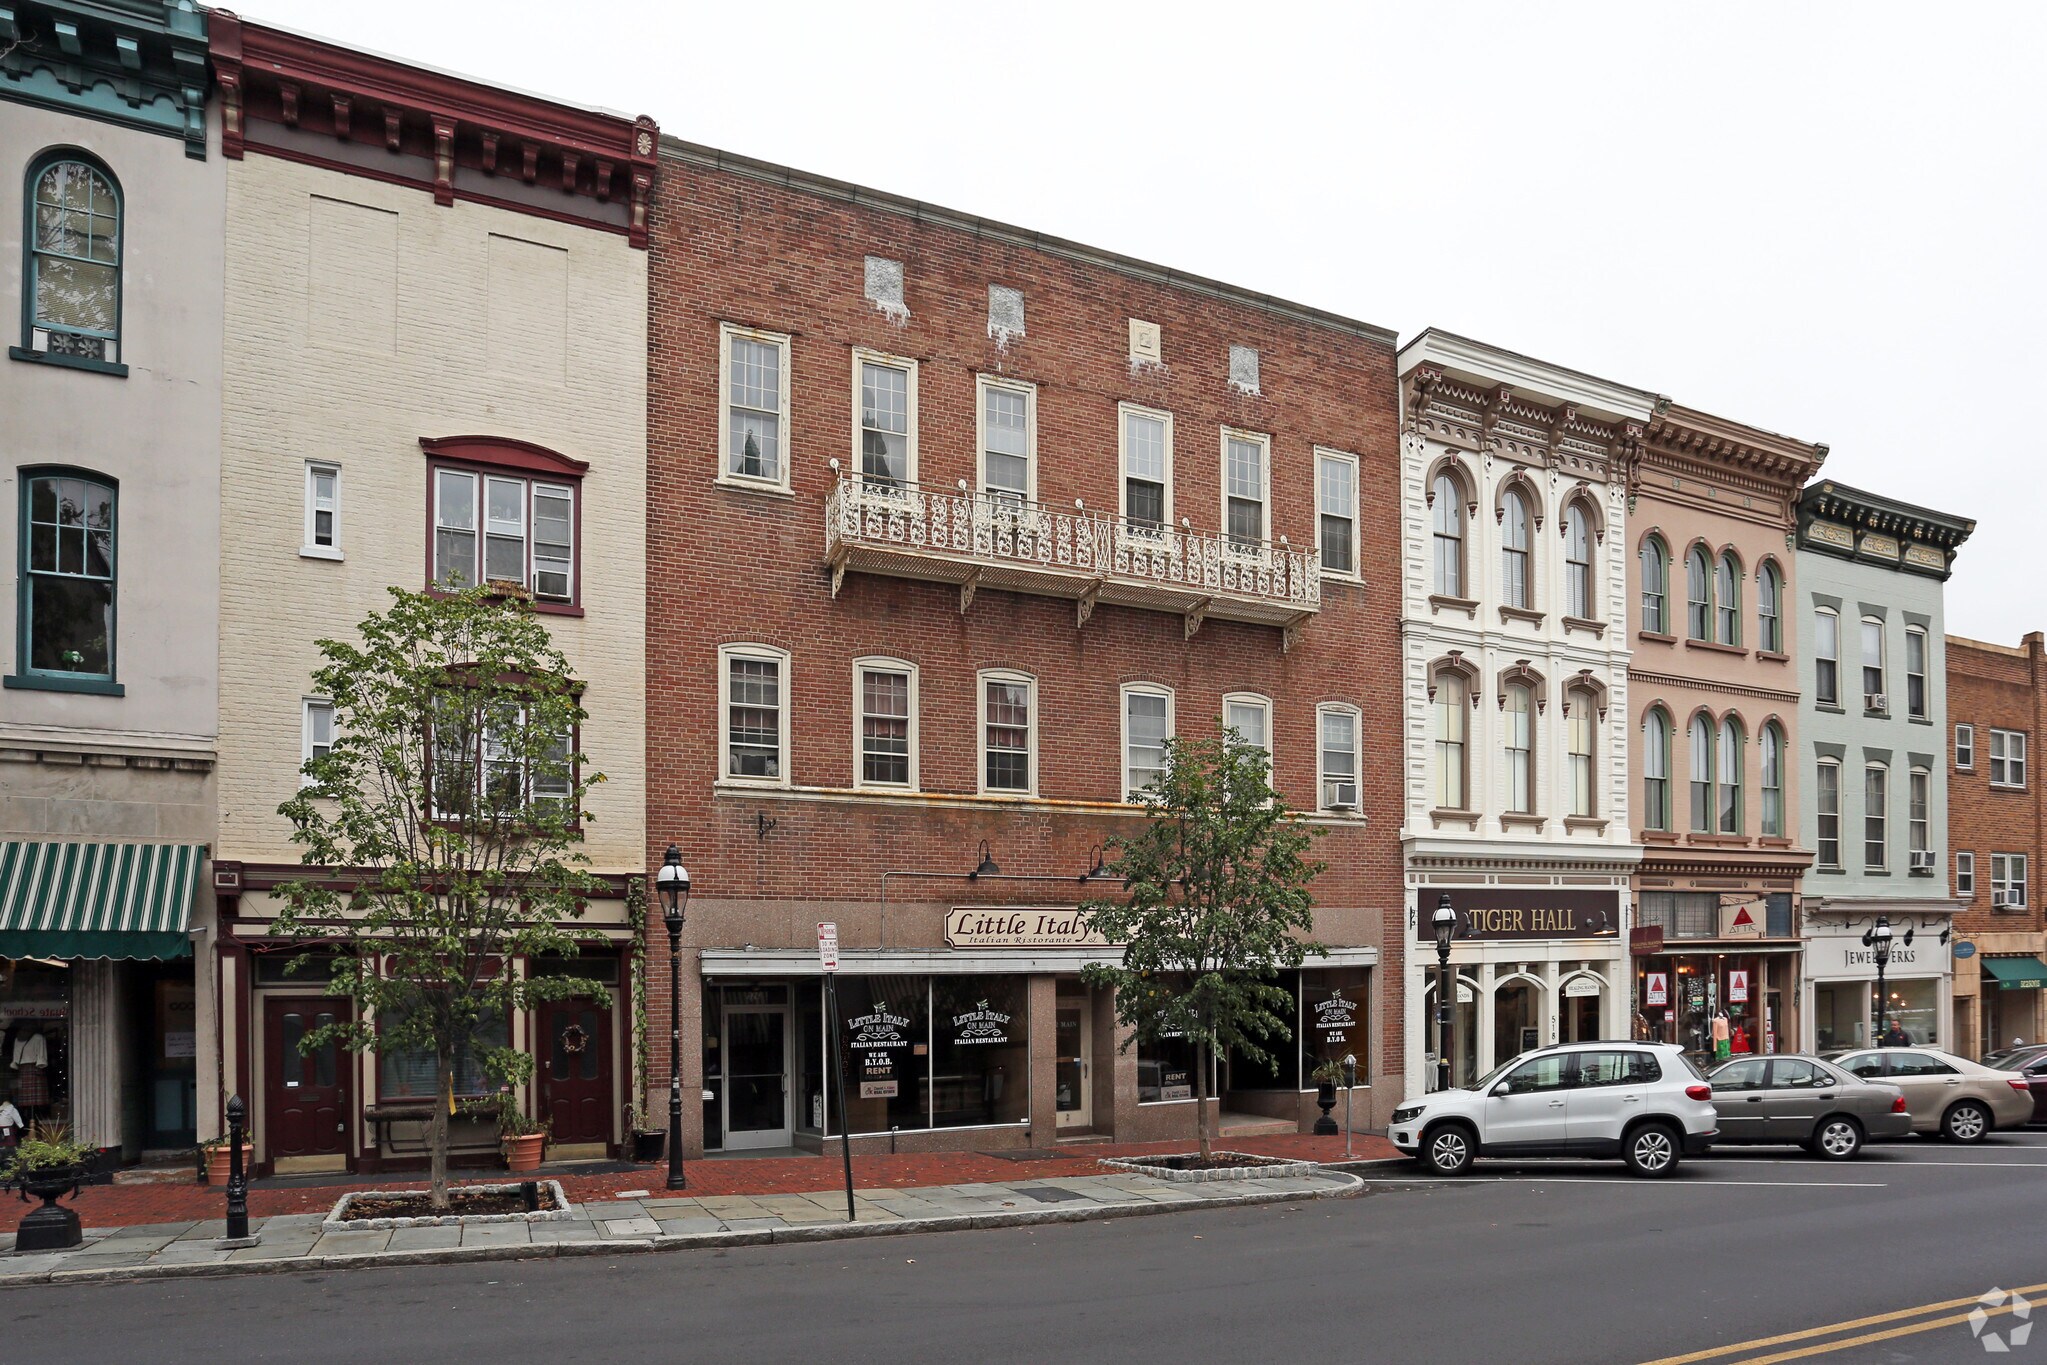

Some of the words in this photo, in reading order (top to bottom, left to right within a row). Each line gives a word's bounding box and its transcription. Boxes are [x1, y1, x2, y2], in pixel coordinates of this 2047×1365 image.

[954, 913, 1026, 935] Little
[1033, 914, 1090, 942] Italy
[1469, 909, 1525, 932] TIGER
[1531, 909, 1576, 931] HALL
[1729, 923, 1756, 934] ATTIC
[968, 936, 1009, 944] Italian
[1013, 936, 1072, 944] Ristorante
[1845, 942, 1915, 968] JEWELERKS
[1314, 999, 1338, 1013] LITTLE
[1338, 998, 1357, 1010] ITALY
[848, 1014, 881, 1029] LITTLE
[882, 1013, 910, 1027] ITALY
[952, 1012, 984, 1026] LITTLE
[985, 1010, 1010, 1024] ITALY
[978, 1021, 995, 1029] MAIN
[866, 1066, 892, 1075] RENT
[1165, 1073, 1187, 1081] RENT
